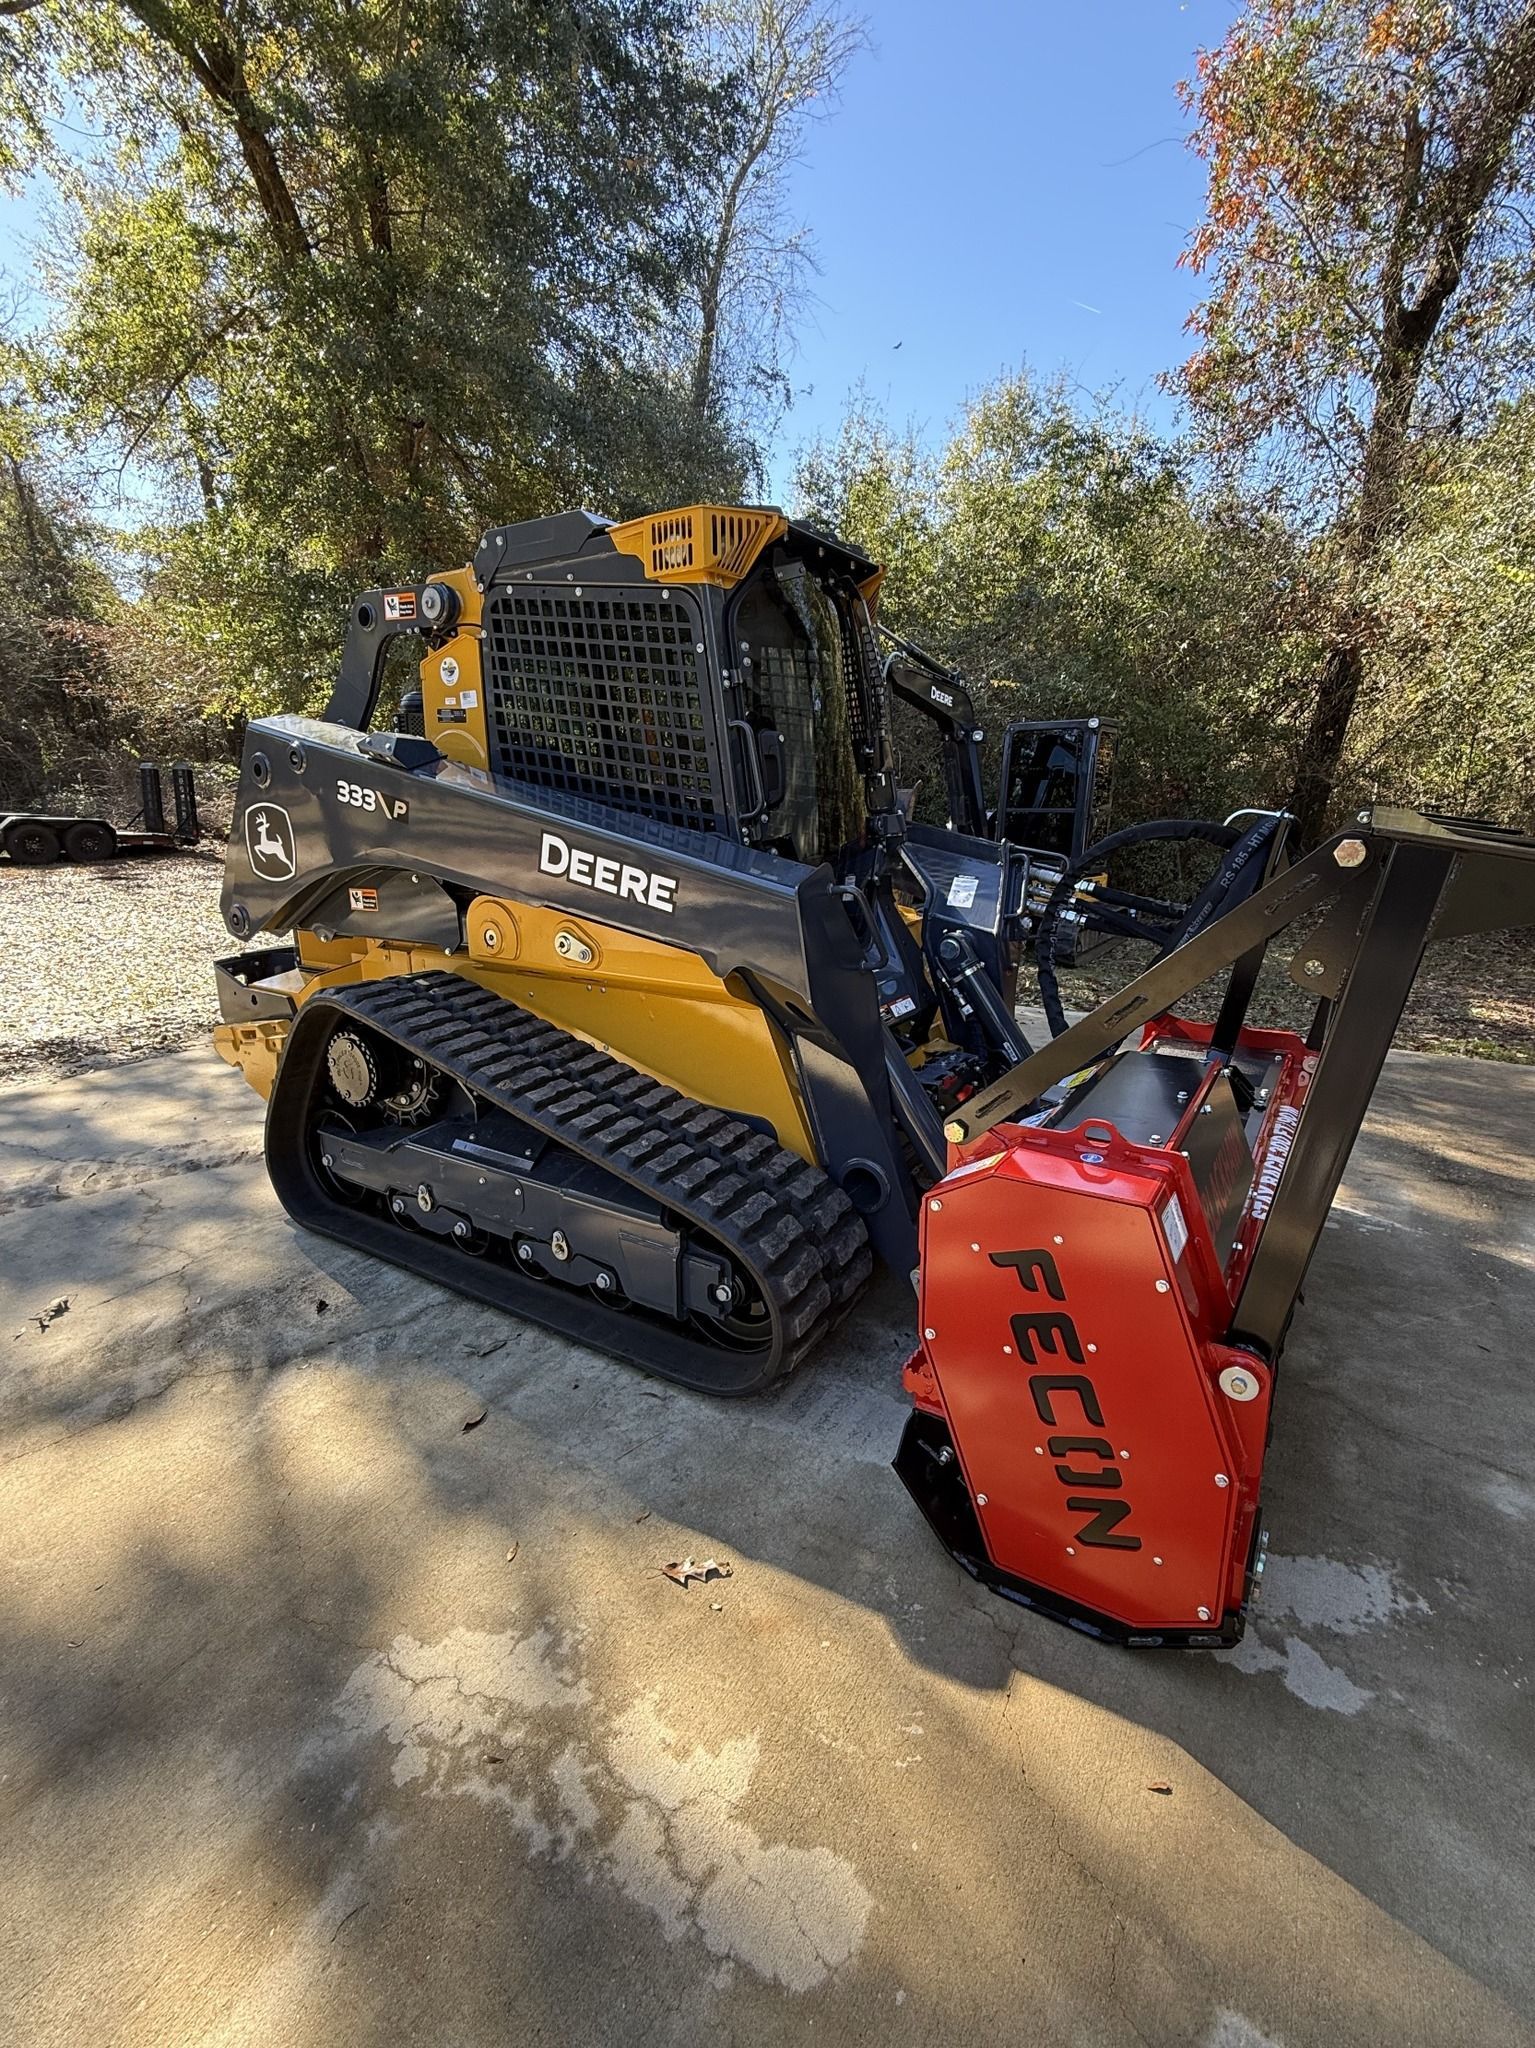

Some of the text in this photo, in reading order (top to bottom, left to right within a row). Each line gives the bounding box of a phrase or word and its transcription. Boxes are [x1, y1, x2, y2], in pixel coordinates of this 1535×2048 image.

[930, 685, 953, 707] DEERE
[540, 833, 677, 913] DEERE
[1220, 871, 1236, 888] RS
[1232, 851, 1249, 870] 185
[1247, 833, 1263, 848] HT
[1268, 1136, 1291, 1156] 300
[1260, 1152, 1285, 1186] BACK
[1251, 1184, 1274, 1220] STAY
[988, 1249, 1142, 1551] FECON
